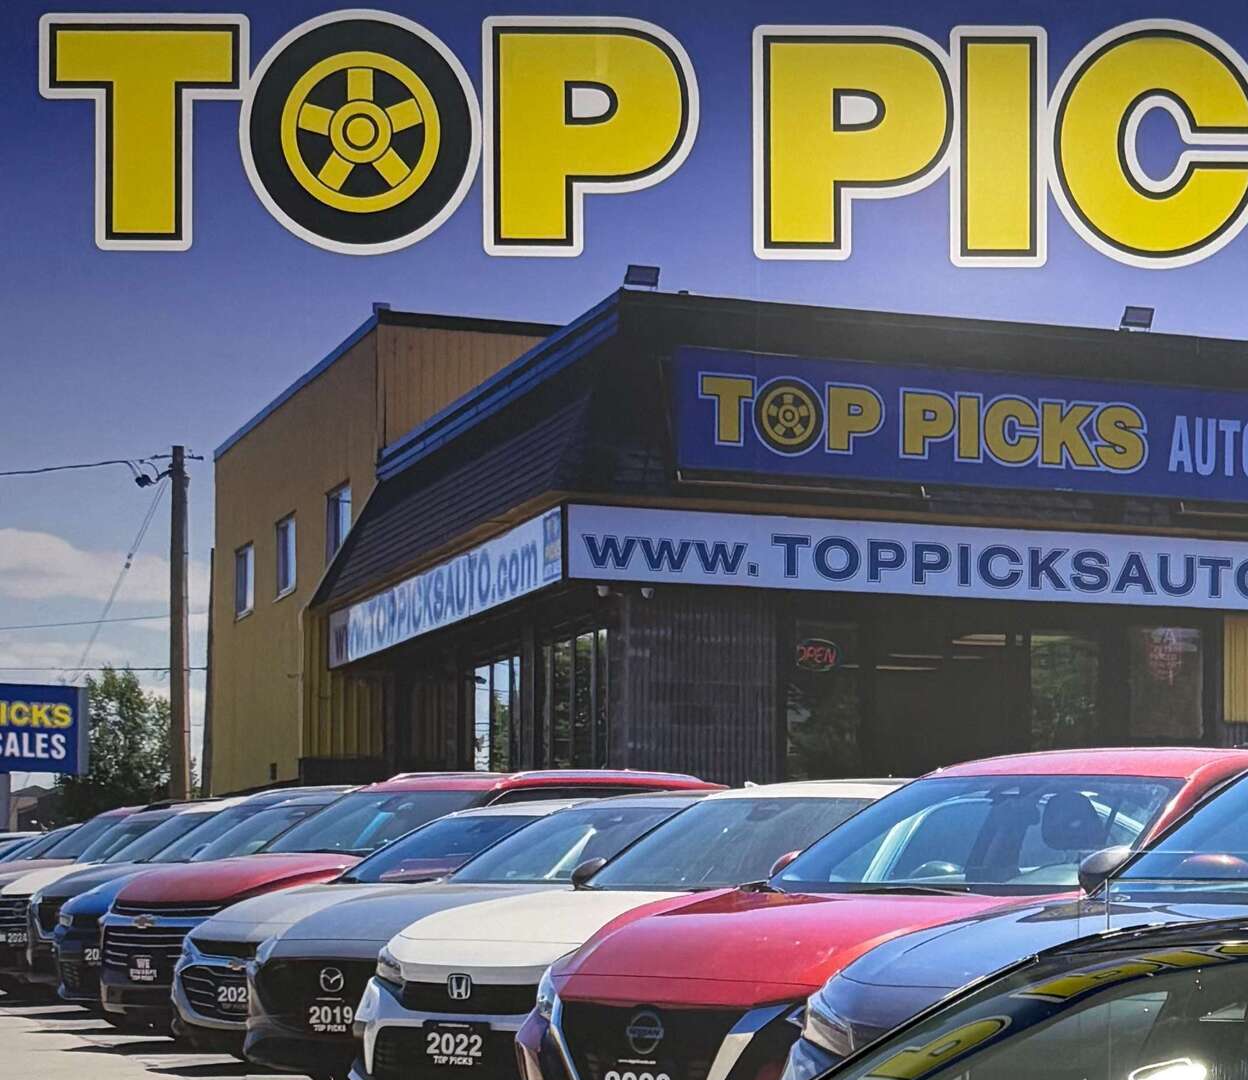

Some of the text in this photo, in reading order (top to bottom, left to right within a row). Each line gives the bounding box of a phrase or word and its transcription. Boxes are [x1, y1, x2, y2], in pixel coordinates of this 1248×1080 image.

[39, 9, 700, 257] TOP
[698, 371, 884, 457] TOP
[899, 387, 1148, 474] PICKS
[0, 732, 66, 759] ALES
[84, 948, 100, 961] 20
[217, 985, 249, 1003] 202
[309, 1005, 353, 1024] 2019
[426, 1032, 483, 1057] 2022
